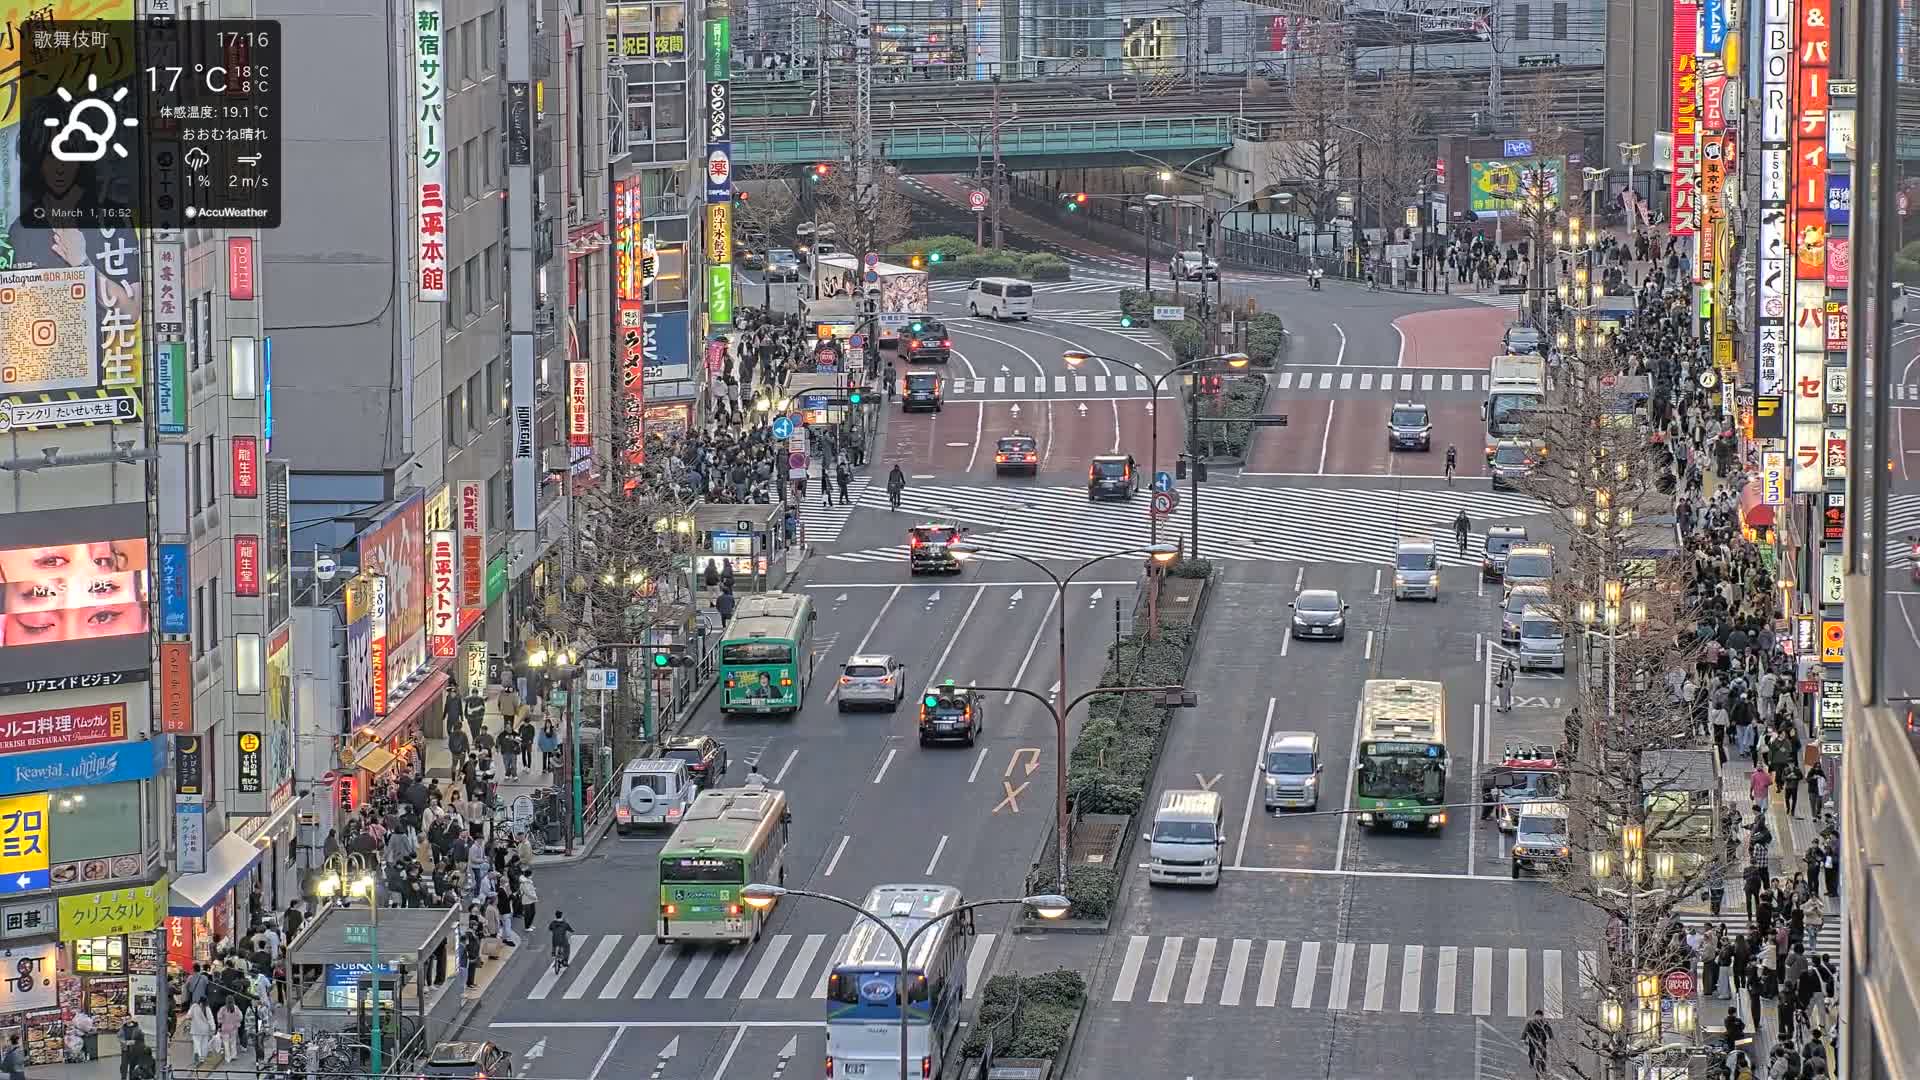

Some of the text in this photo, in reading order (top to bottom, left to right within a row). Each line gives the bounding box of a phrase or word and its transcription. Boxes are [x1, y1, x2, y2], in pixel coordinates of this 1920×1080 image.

[622, 36, 650, 54] 祝日
[655, 34, 684, 53] 夜間
[418, 10, 442, 169] 新宿サンパーク
[1678, 53, 1696, 135] パチンコ
[1708, 86, 1721, 119] アコム
[711, 84, 726, 137] もつなべ
[710, 160, 728, 177] 薬
[1771, 151, 1780, 200] ESOLA
[1674, 144, 1697, 232] エスパス
[420, 183, 445, 291] 三平本館
[713, 206, 727, 262] 肉汁水餃子
[0, 272, 43, 286] Instagram
[712, 274, 726, 312] レイク
[1827, 303, 1838, 312] 6F
[159, 323, 178, 333] 3F
[623, 329, 641, 387] ラーメン
[1762, 328, 1777, 382] 大衆酒場
[159, 351, 171, 414] FamilyMart
[1797, 306, 1824, 469] パセラ
[16, 404, 114, 420] テンクリ たいせい先生
[1831, 404, 1845, 414] 5F
[516, 406, 532, 460] HOMEGAME
[237, 448, 252, 488] 龍生堂
[463, 486, 475, 530] GAME
[1830, 495, 1843, 505] 3F
[715, 539, 729, 551] 10
[163, 554, 175, 605] ゲウチャイ
[239, 546, 254, 582] 龍生堂
[435, 541, 453, 628] 三平ストア
[442, 647, 455, 655] B2
[26, 671, 123, 693] リアエイドビジョン
[28, 734, 72, 746] RESTAURANT
[168, 720, 185, 730] B2
[2, 810, 42, 836] プロ
[2, 835, 43, 857] ミス
[7, 910, 42, 930] 囲碁
[72, 902, 145, 925] クリスタル
[329, 990, 345, 1003] 12
